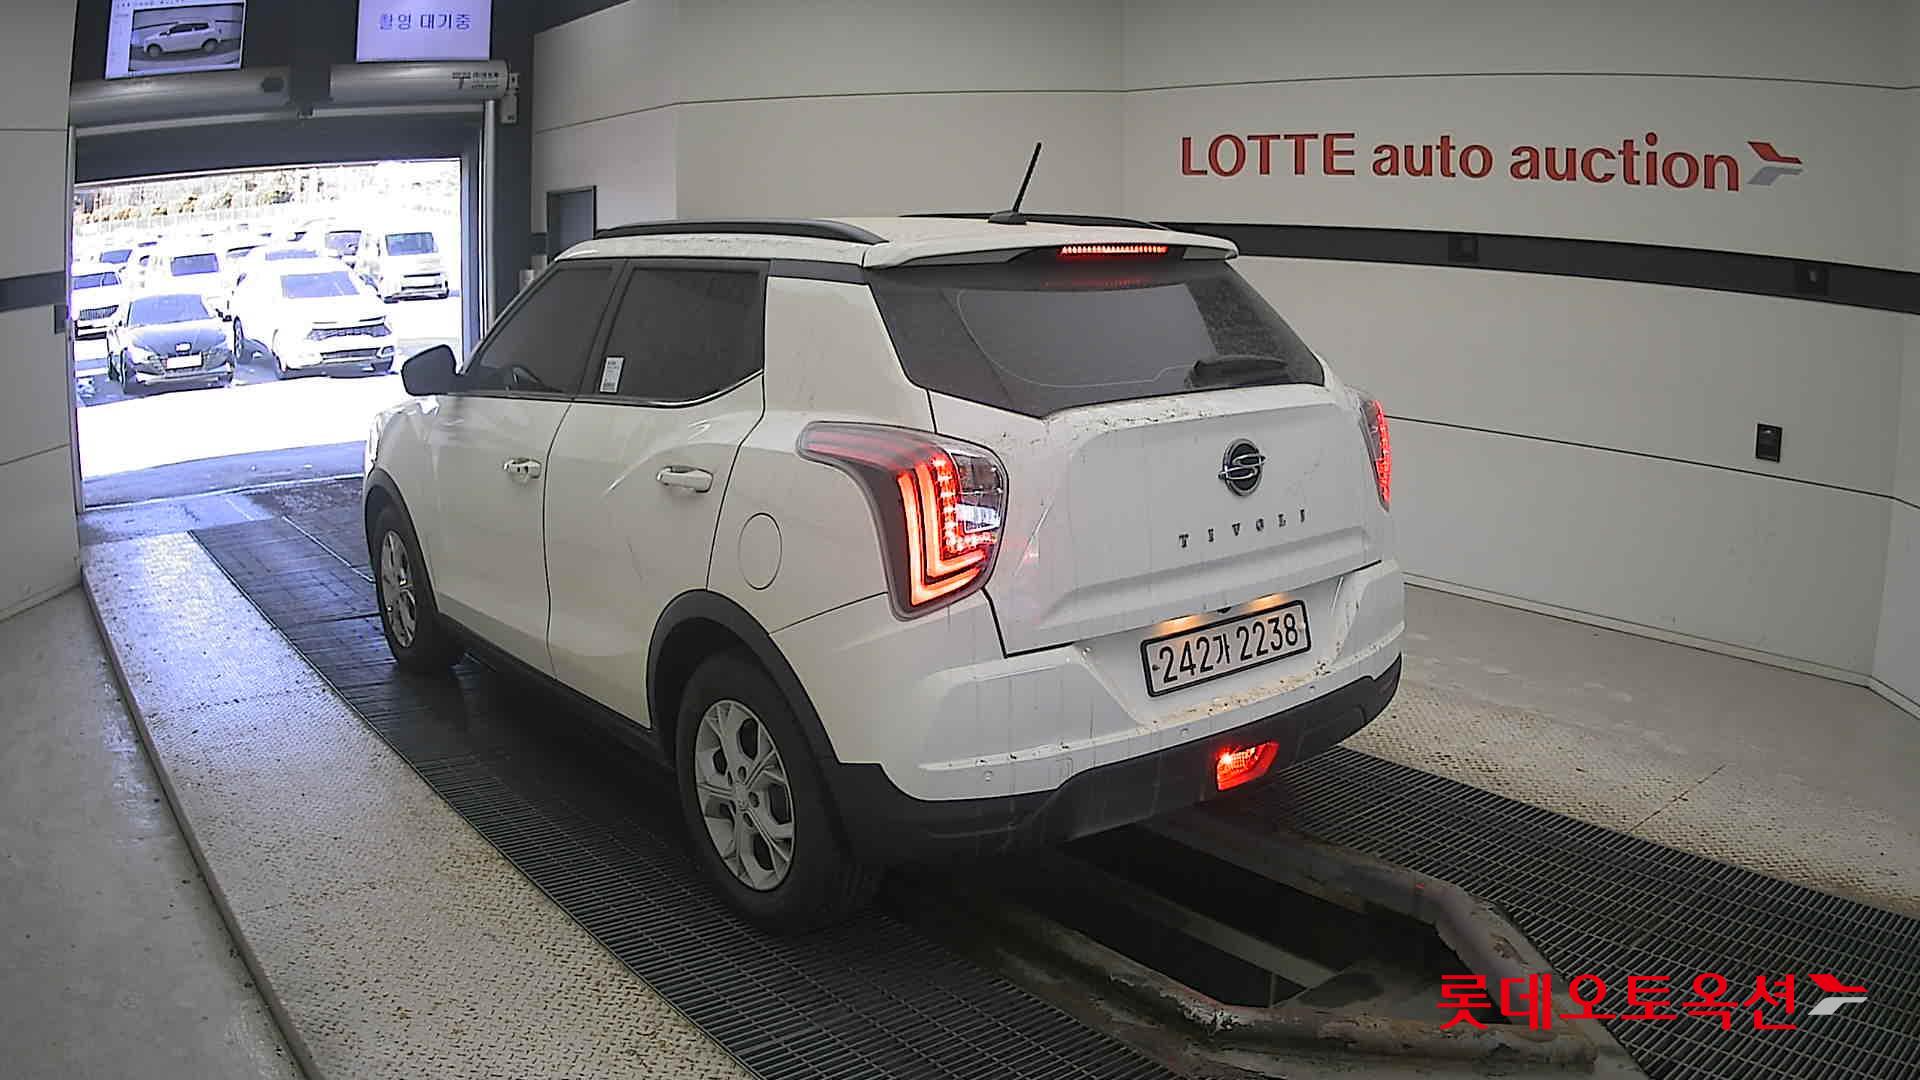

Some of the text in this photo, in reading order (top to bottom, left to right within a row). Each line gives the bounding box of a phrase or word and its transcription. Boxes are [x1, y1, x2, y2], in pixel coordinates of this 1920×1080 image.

[420, 13, 471, 30] 대기중
[1182, 132, 1740, 191] LOTTE auto auction
[1178, 508, 1305, 548] TIVOLI
[1159, 613, 1298, 684] 242가 2238
